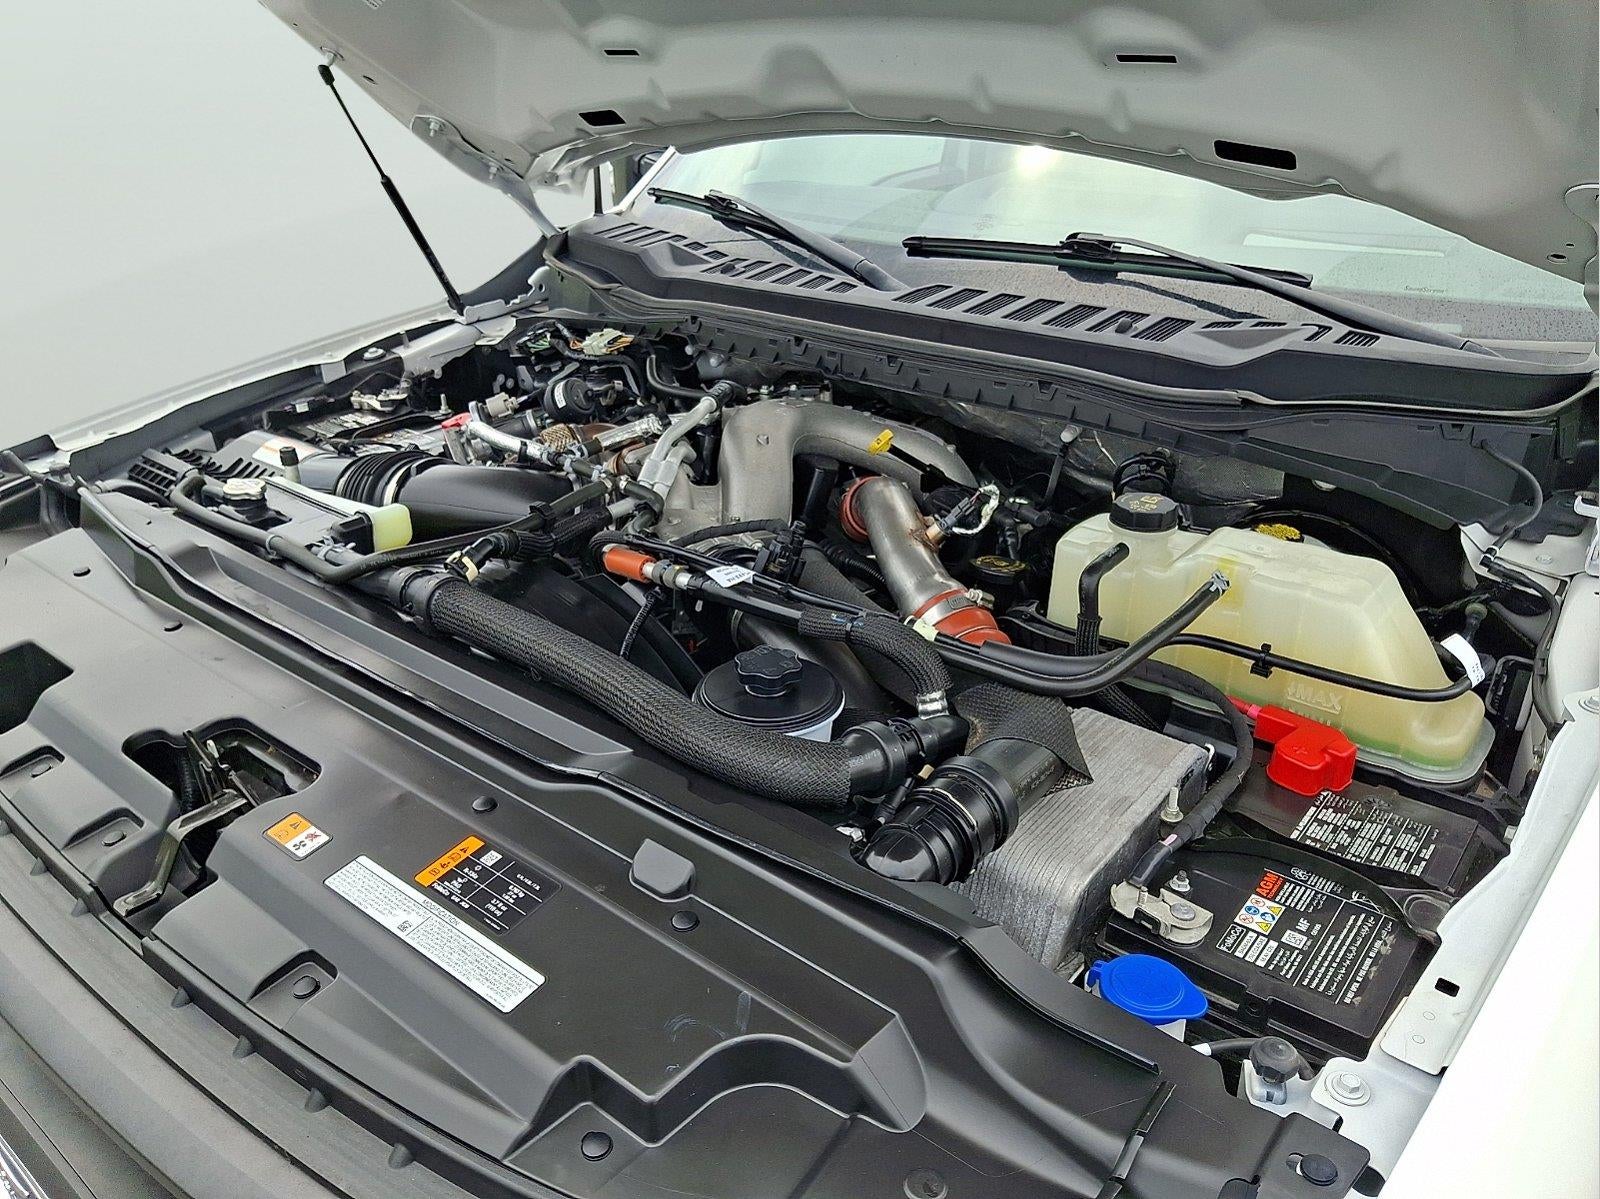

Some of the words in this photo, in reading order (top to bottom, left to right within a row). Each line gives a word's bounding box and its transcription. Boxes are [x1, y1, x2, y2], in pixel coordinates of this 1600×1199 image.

[1256, 873, 1278, 896] AGM
[1296, 918, 1310, 932] MF
[1220, 927, 1242, 952] FoMoCo
